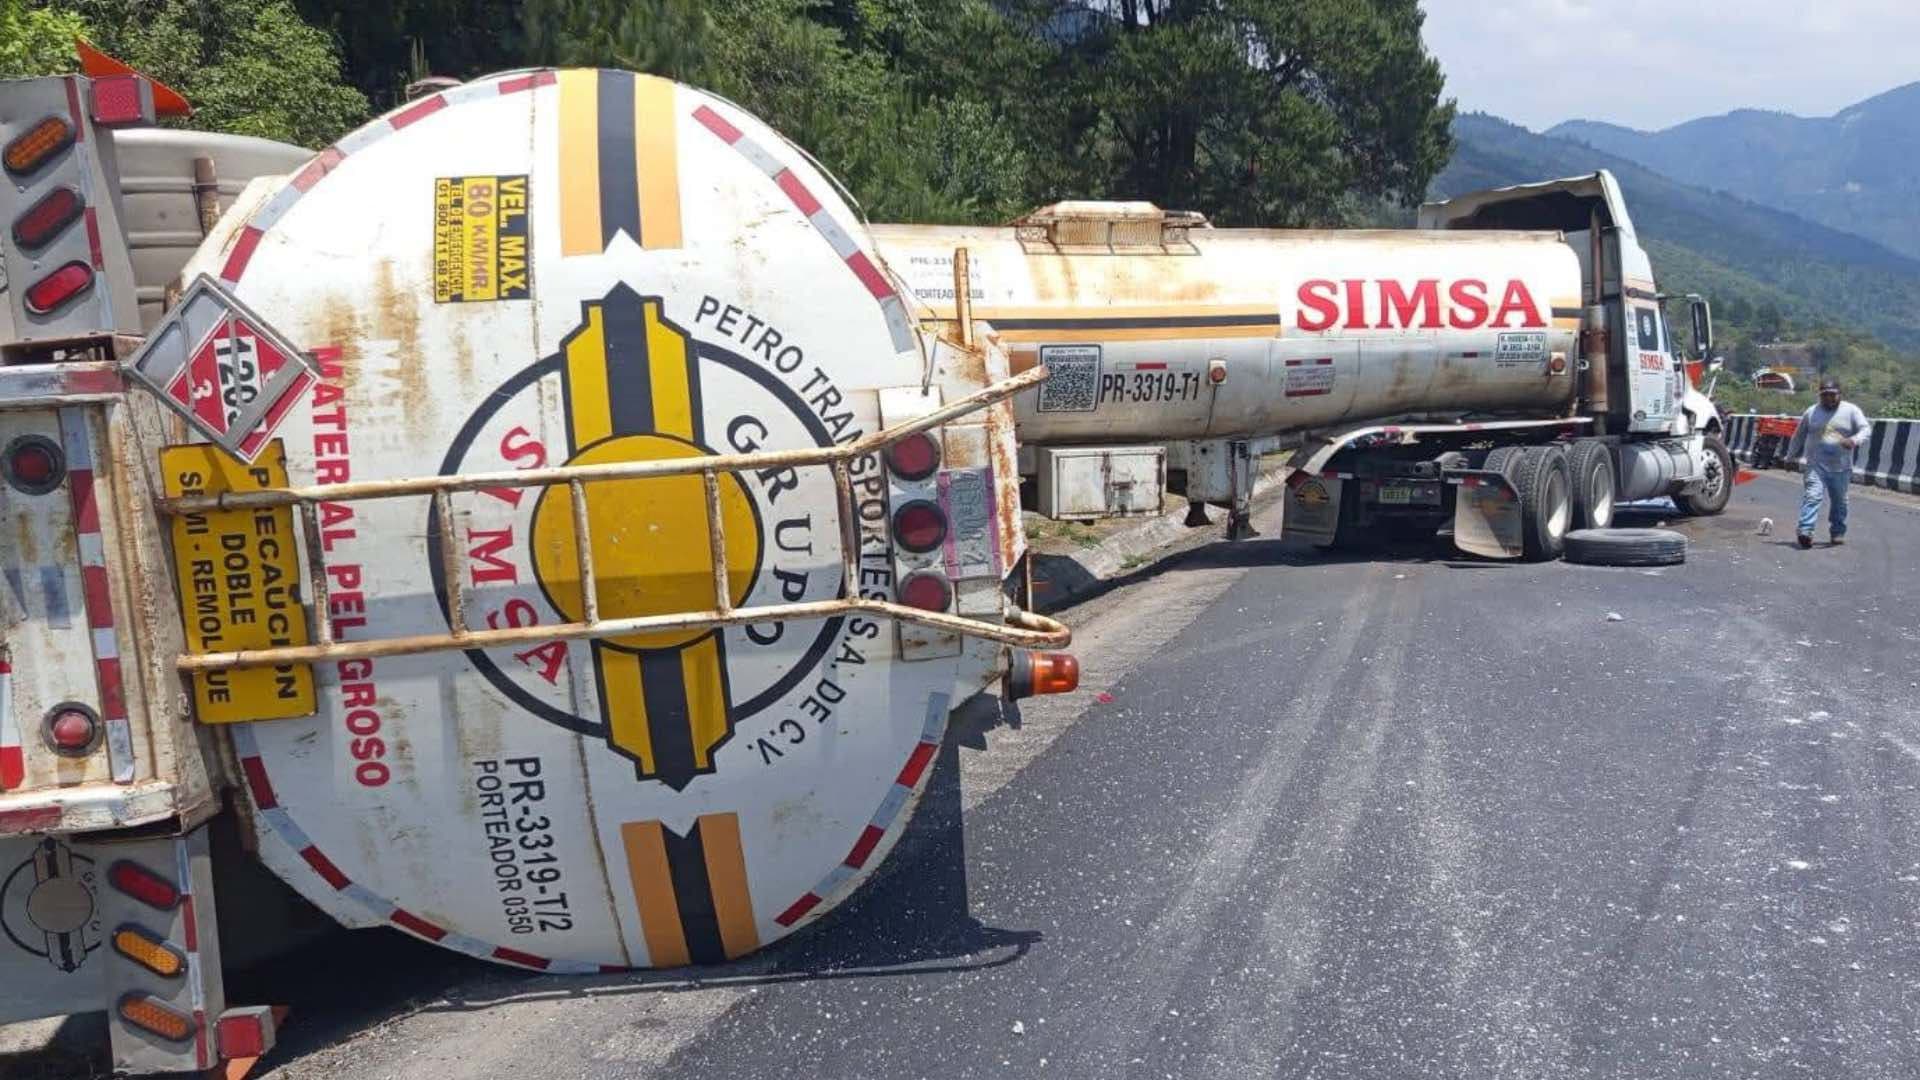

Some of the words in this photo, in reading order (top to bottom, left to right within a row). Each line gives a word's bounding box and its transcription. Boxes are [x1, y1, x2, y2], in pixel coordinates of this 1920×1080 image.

[438, 183, 449, 199] 01
[438, 204, 449, 227] 800
[467, 184, 493, 218] 80
[500, 177, 526, 229] VEL.
[438, 231, 449, 254] 711
[500, 236, 527, 298] MAX.
[1296, 278, 1547, 332] SIMSA
[695, 294, 804, 374] PETRO
[192, 379, 213, 400] 3
[1101, 372, 1200, 403] PR-3319-T1
[310, 345, 357, 551] MATERAL
[467, 425, 569, 687] SIMSA
[726, 414, 813, 646] GRUPO
[221, 533, 256, 626] DOBLE
[191, 559, 230, 705] REMOLUE
[830, 617, 879, 670] S.A.
[326, 563, 391, 788] PELGROSO
[799, 677, 847, 724] DE
[746, 718, 806, 766] C.V.
[473, 759, 523, 893] PORTEADOR
[502, 896, 534, 935] 0350
[505, 756, 573, 933] PR-3319-T/2
